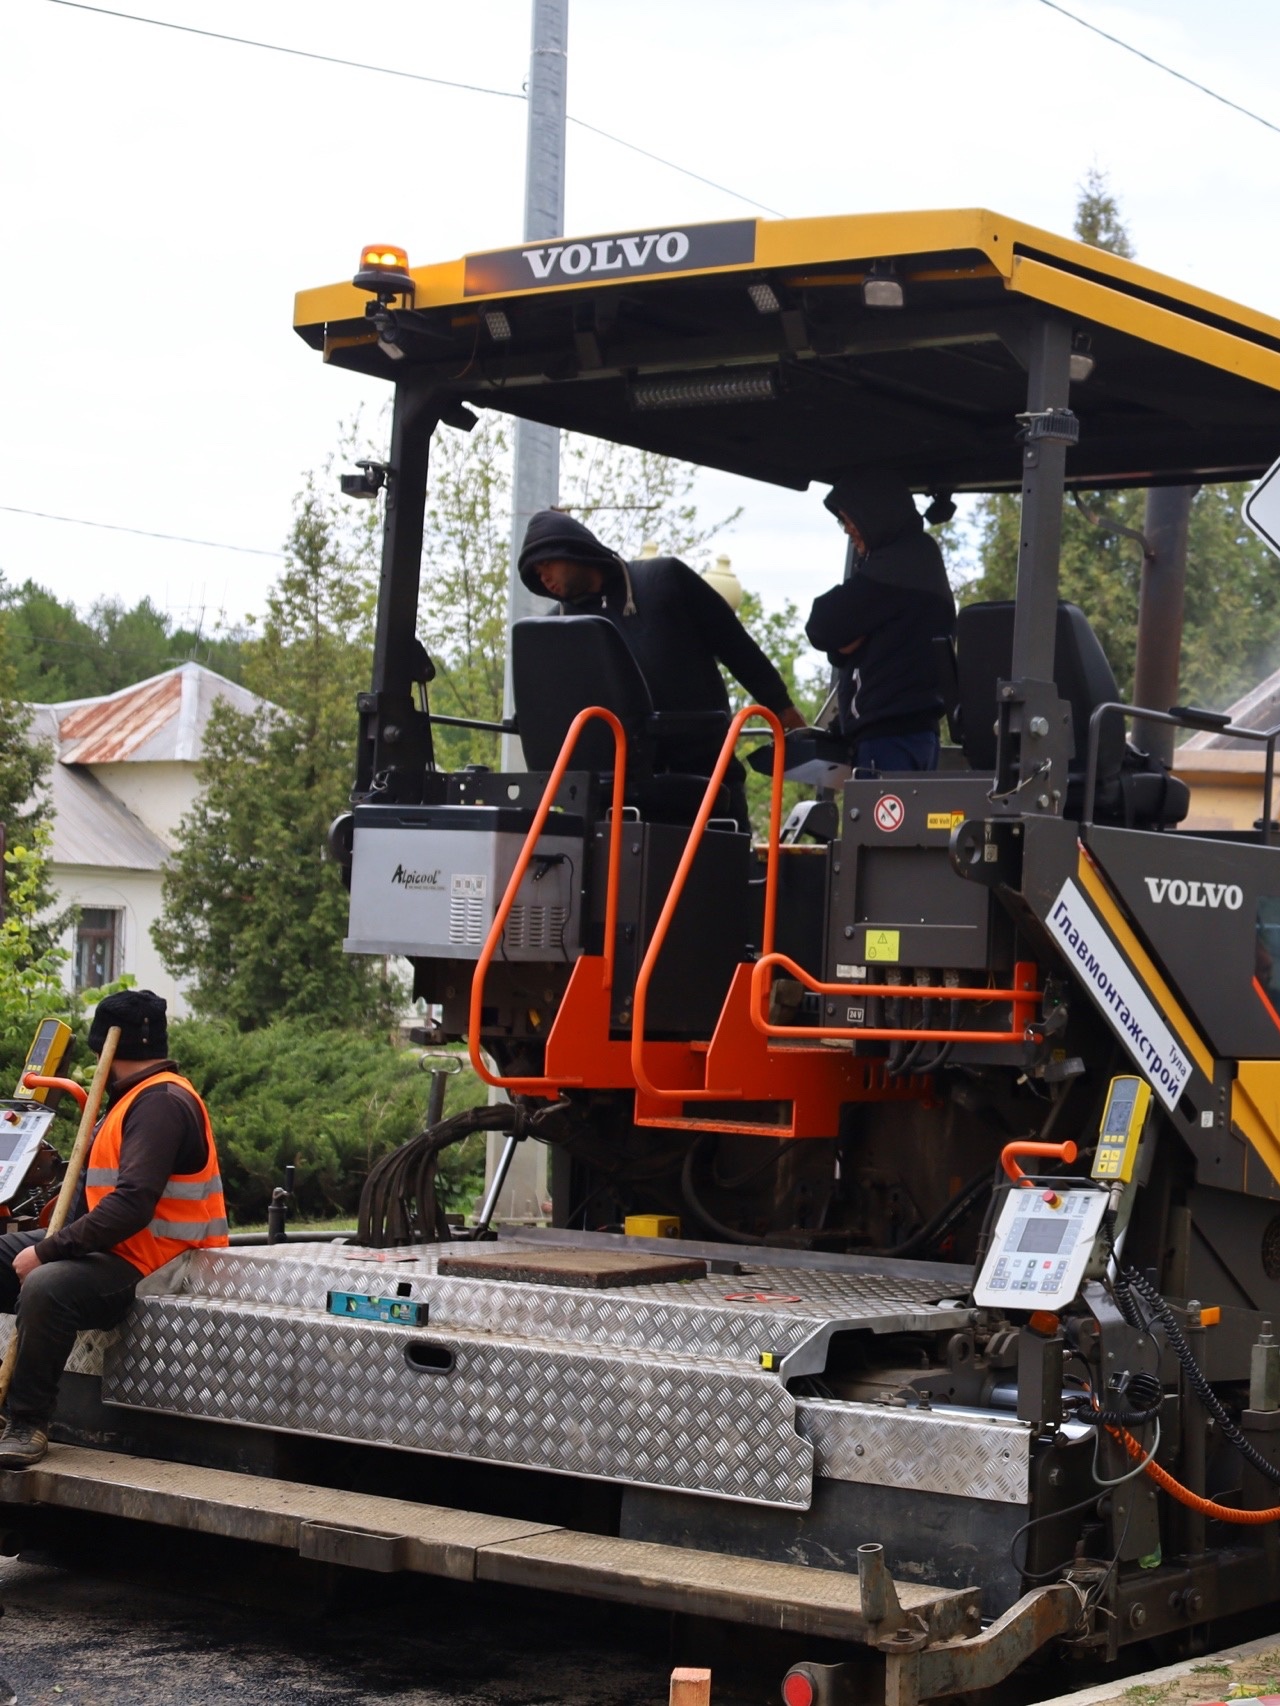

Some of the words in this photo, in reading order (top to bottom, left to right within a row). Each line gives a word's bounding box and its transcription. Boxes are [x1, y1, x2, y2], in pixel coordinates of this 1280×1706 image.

[522, 231, 690, 279] VOLVO
[391, 863, 438, 889] Alpicool
[1144, 877, 1243, 910] VOLVO
[849, 1010, 857, 1019] 24
[1053, 900, 1180, 1098] Главмонтажстрой
[1168, 1044, 1188, 1077] Тула
